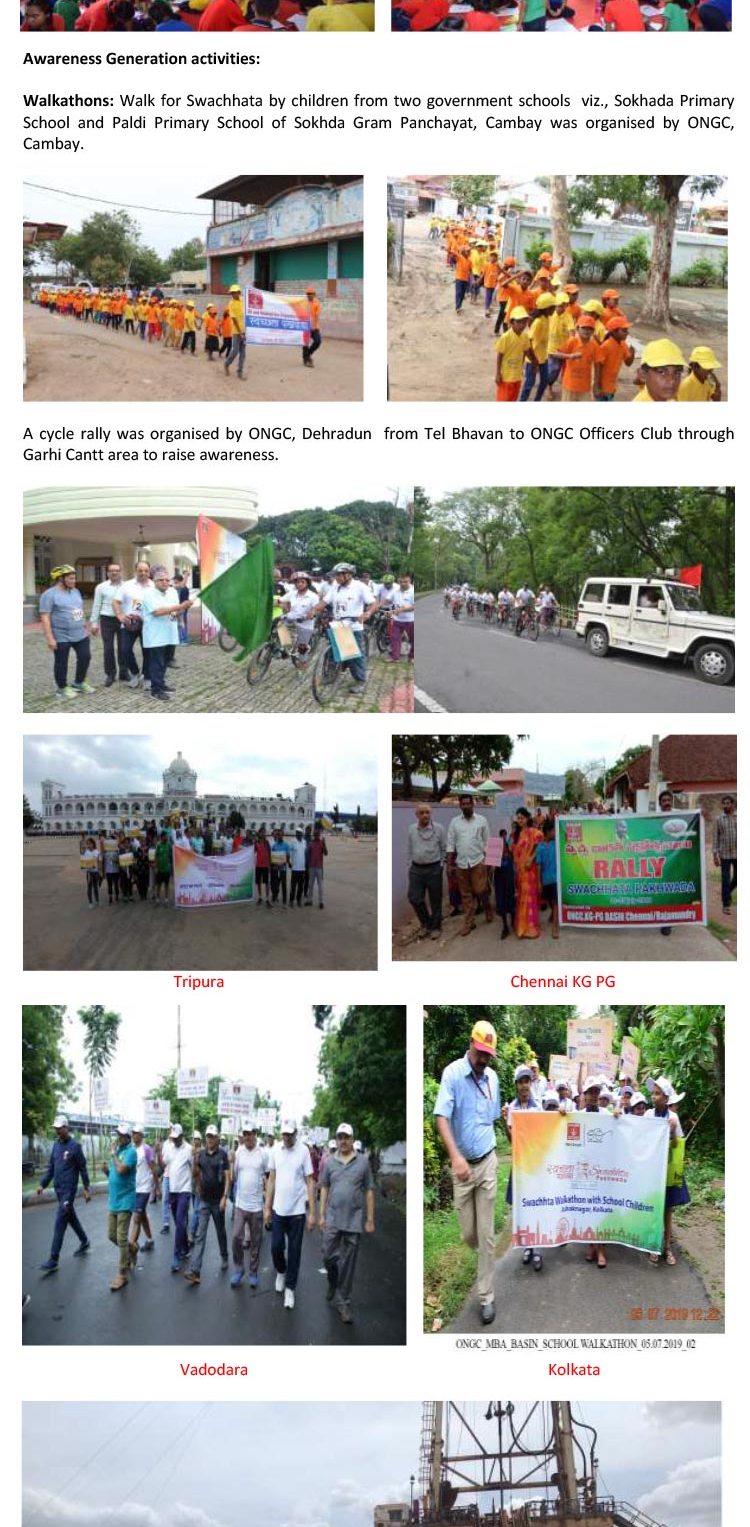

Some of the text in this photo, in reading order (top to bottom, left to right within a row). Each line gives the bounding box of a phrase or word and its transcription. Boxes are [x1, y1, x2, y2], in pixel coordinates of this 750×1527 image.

[23, 52, 260, 65] Awareness Generation activities:
[593, 857, 666, 879] RALLY
[173, 975, 224, 990] Tripura
[511, 975, 615, 987] Chennai KG PG
[522, 1195, 654, 1212] Swachhta Walkathon with School Children
[180, 1363, 247, 1376] Vadodara
[549, 1363, 600, 1376] Kolkata
